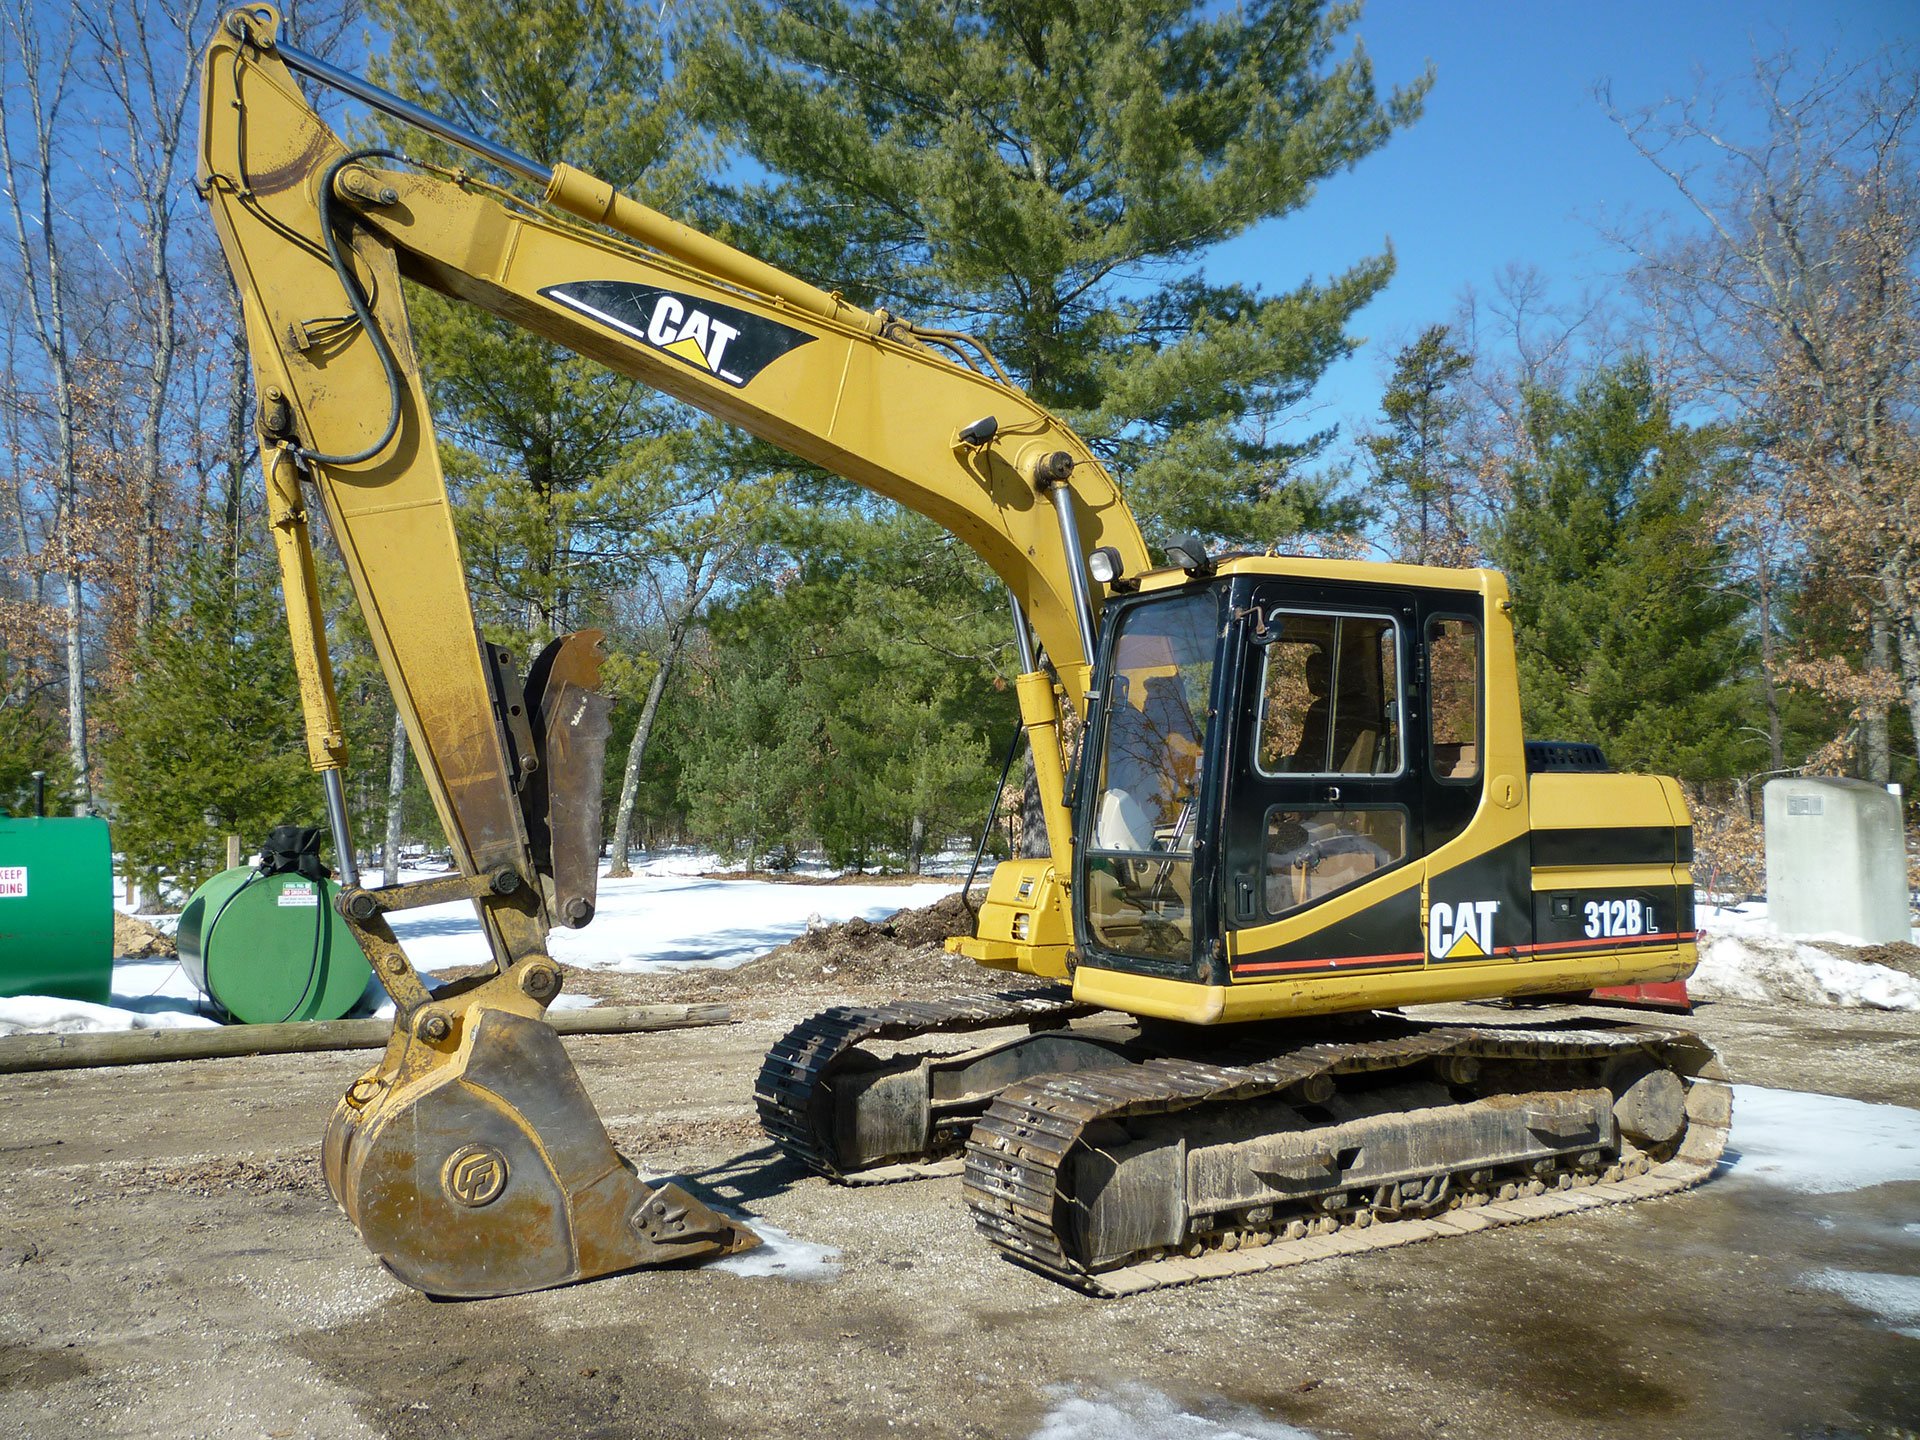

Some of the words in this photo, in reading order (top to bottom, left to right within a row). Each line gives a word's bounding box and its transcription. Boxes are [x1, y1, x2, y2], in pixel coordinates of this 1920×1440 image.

[648, 296, 738, 373] CAT
[1430, 901, 1497, 959] CAT
[1584, 899, 1641, 938] 312B
[1646, 906, 1659, 934] L
